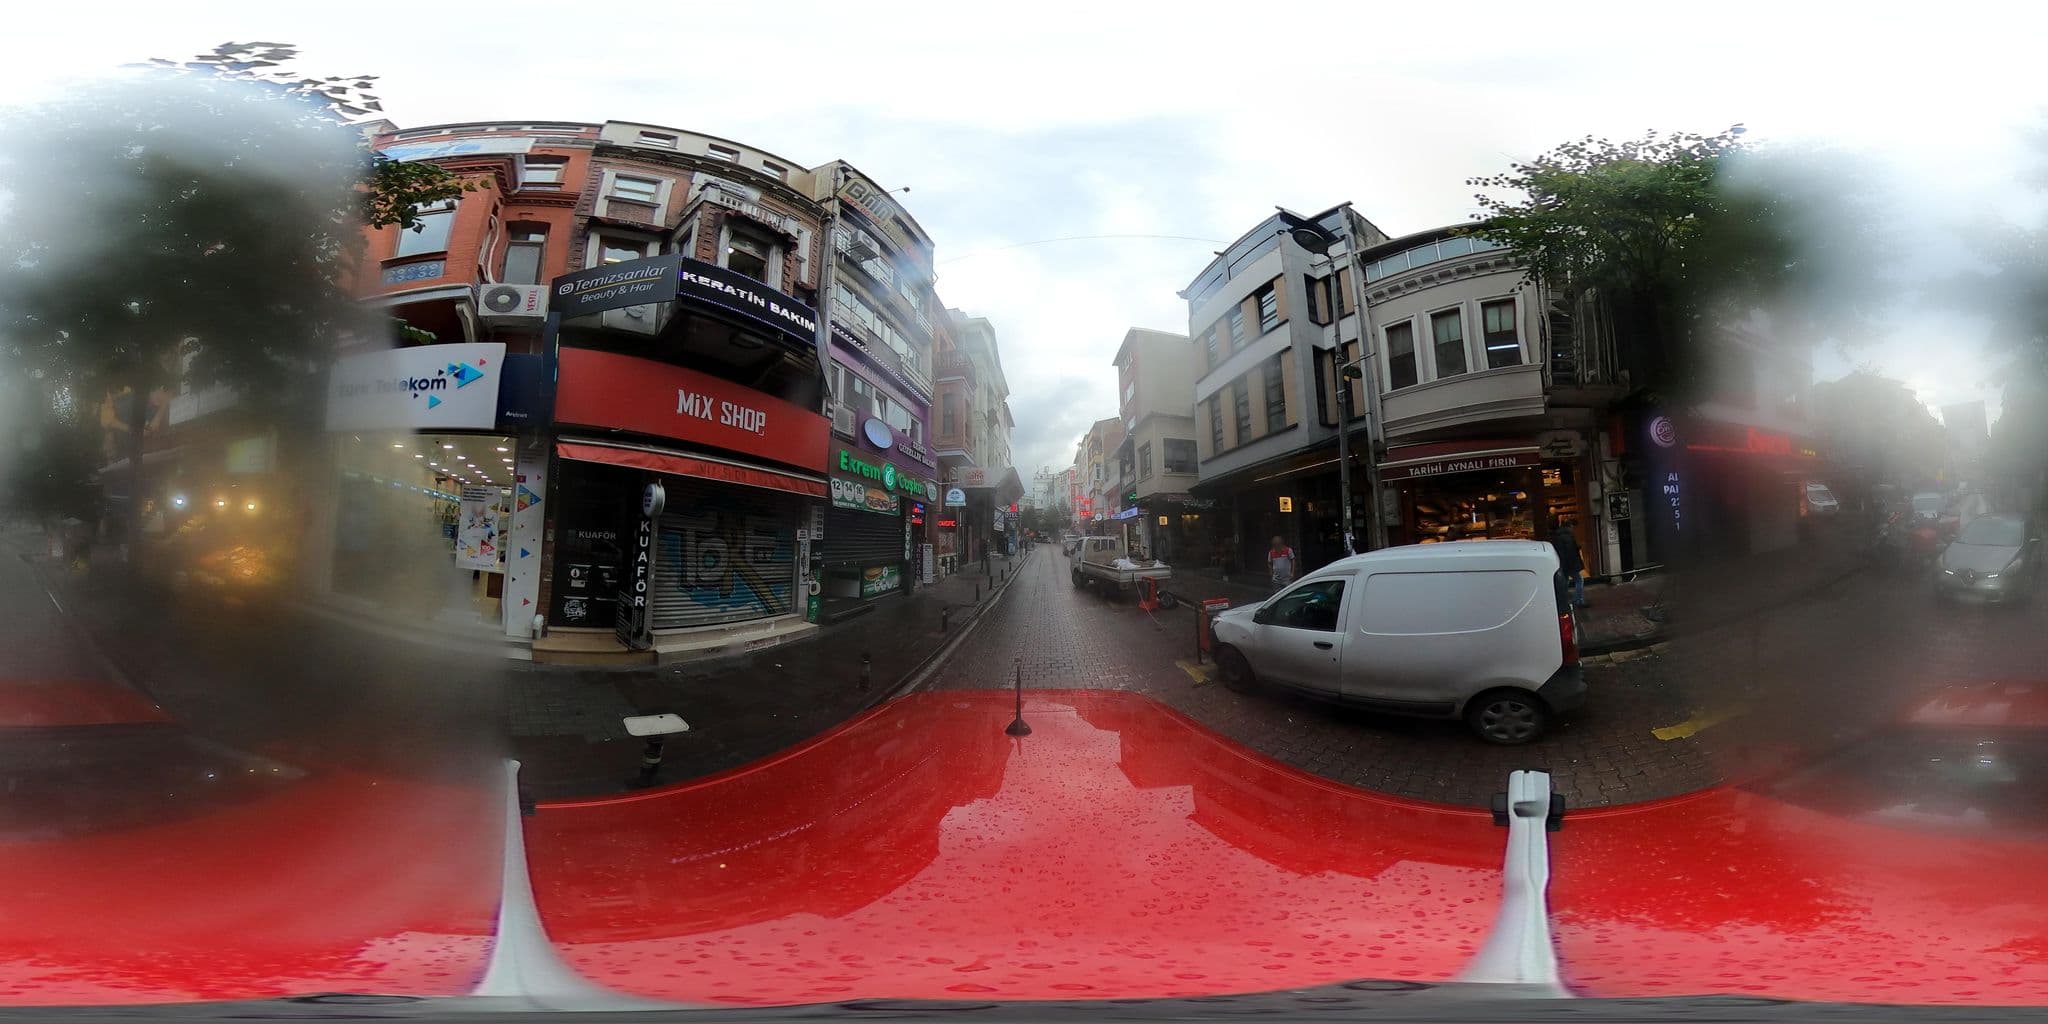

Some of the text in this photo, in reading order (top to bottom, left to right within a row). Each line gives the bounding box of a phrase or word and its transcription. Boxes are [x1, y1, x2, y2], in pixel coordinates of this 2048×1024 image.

[581, 282, 655, 303] Beauty & Hair
[681, 270, 815, 332] KERATİN BAKIM
[721, 401, 766, 434] SHOP
[839, 449, 881, 480] Ekrem
[1409, 457, 1516, 476] TARİHİ AYNALI FIRIN
[832, 480, 841, 491] 12
[578, 531, 617, 540] KUAFÖR
[635, 521, 650, 607] KUAFÖR
